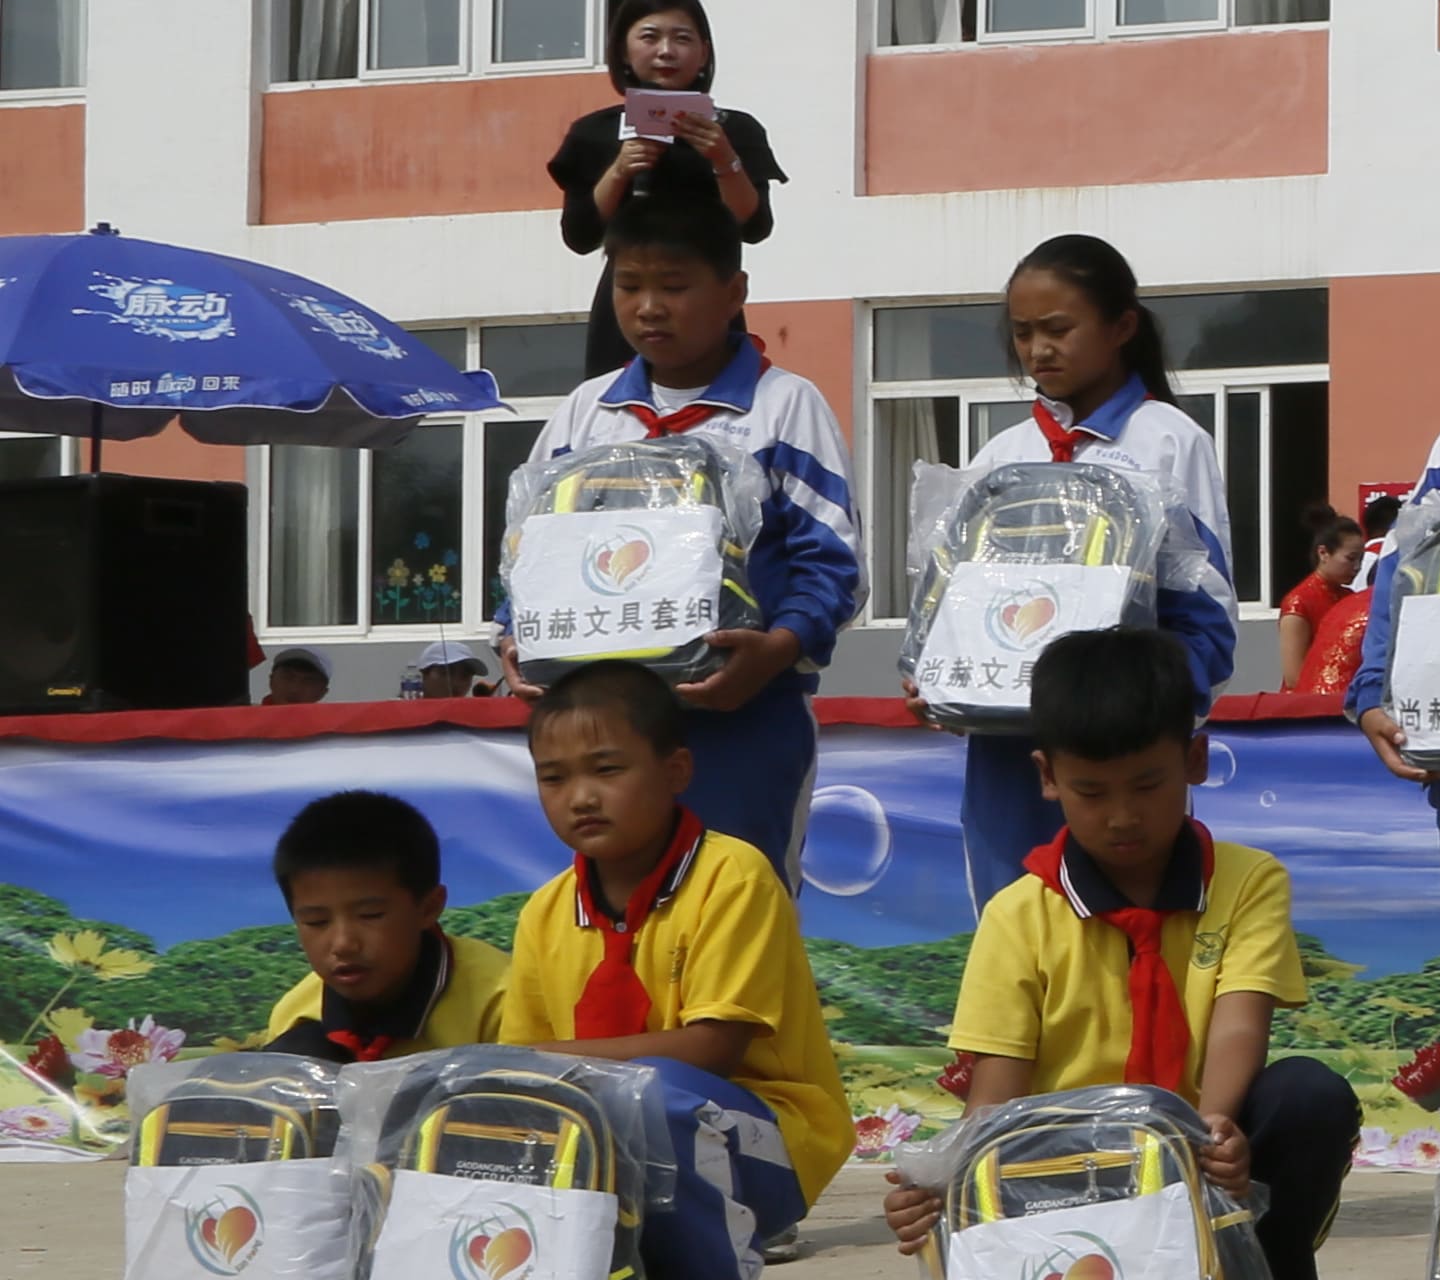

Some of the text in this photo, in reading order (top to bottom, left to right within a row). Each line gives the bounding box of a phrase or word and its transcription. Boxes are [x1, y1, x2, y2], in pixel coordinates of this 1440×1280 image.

[122, 292, 227, 320] 脉动
[516, 596, 714, 643] 尚赫文具套组
